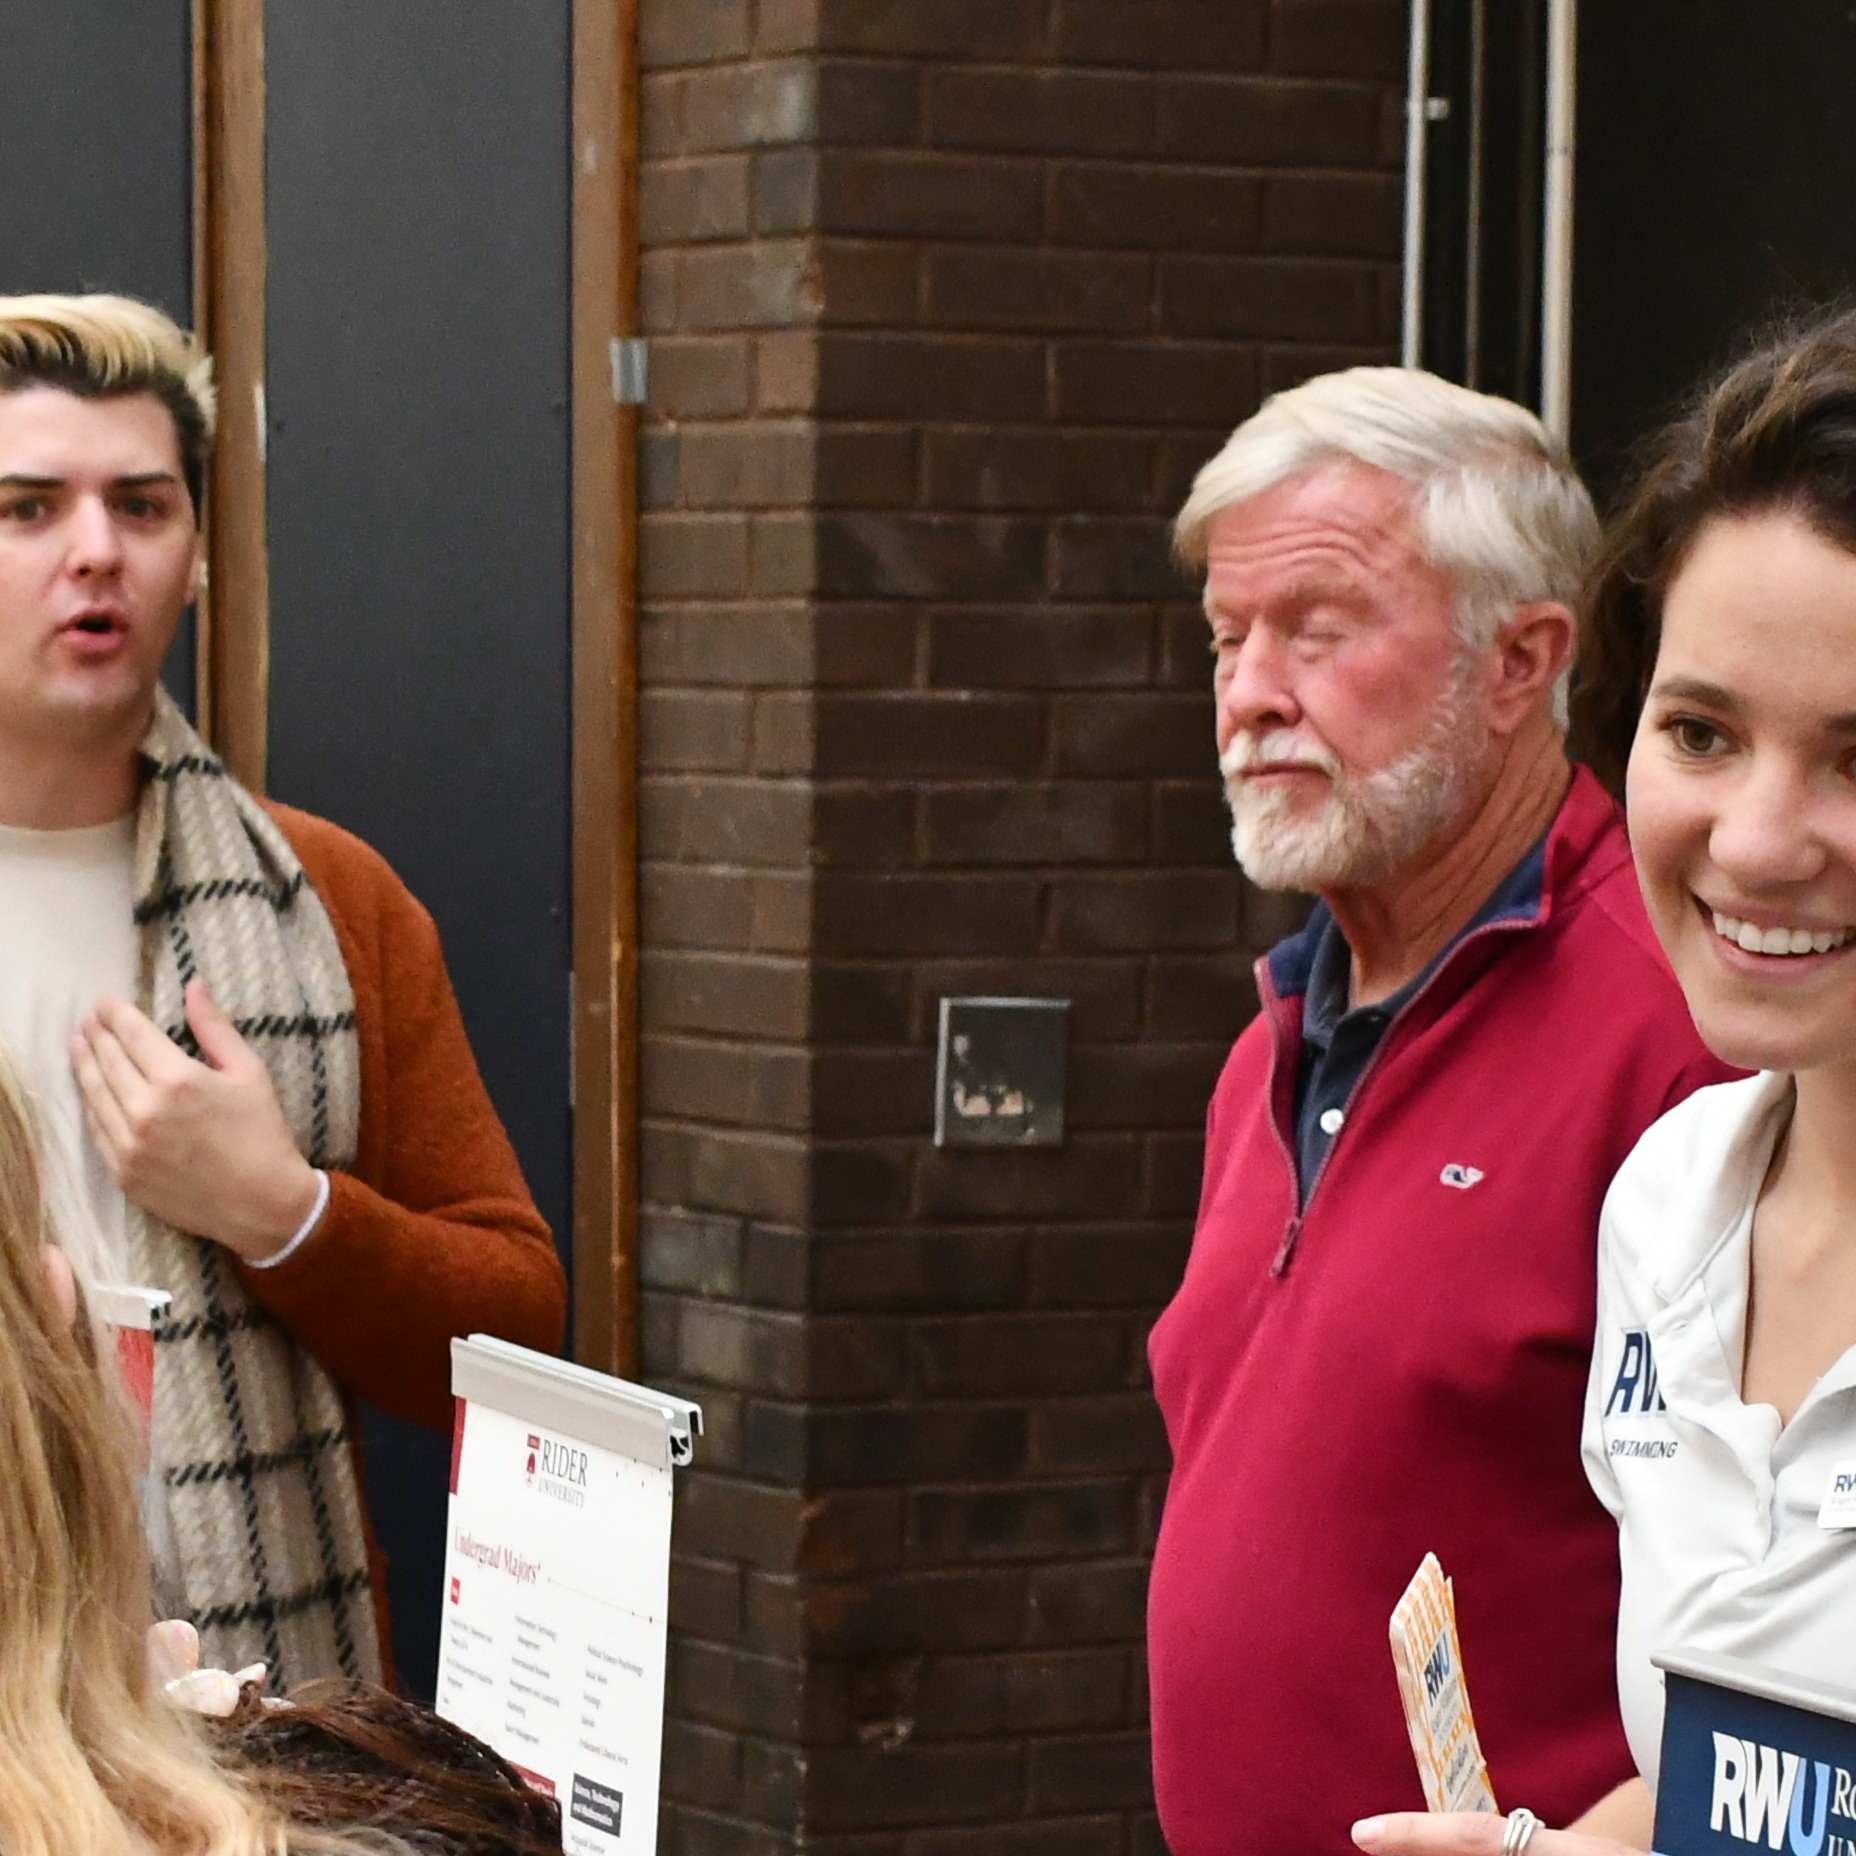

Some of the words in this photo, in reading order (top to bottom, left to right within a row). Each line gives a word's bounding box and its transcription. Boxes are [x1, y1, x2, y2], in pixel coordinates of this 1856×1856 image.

[542, 1439, 588, 1486] RIDER
[1610, 1439, 1678, 1458] SWIMMING
[539, 1478, 584, 1508] UNIVERSITY
[455, 1527, 501, 1568] Undergrad
[1424, 1631, 1450, 1707] RWU
